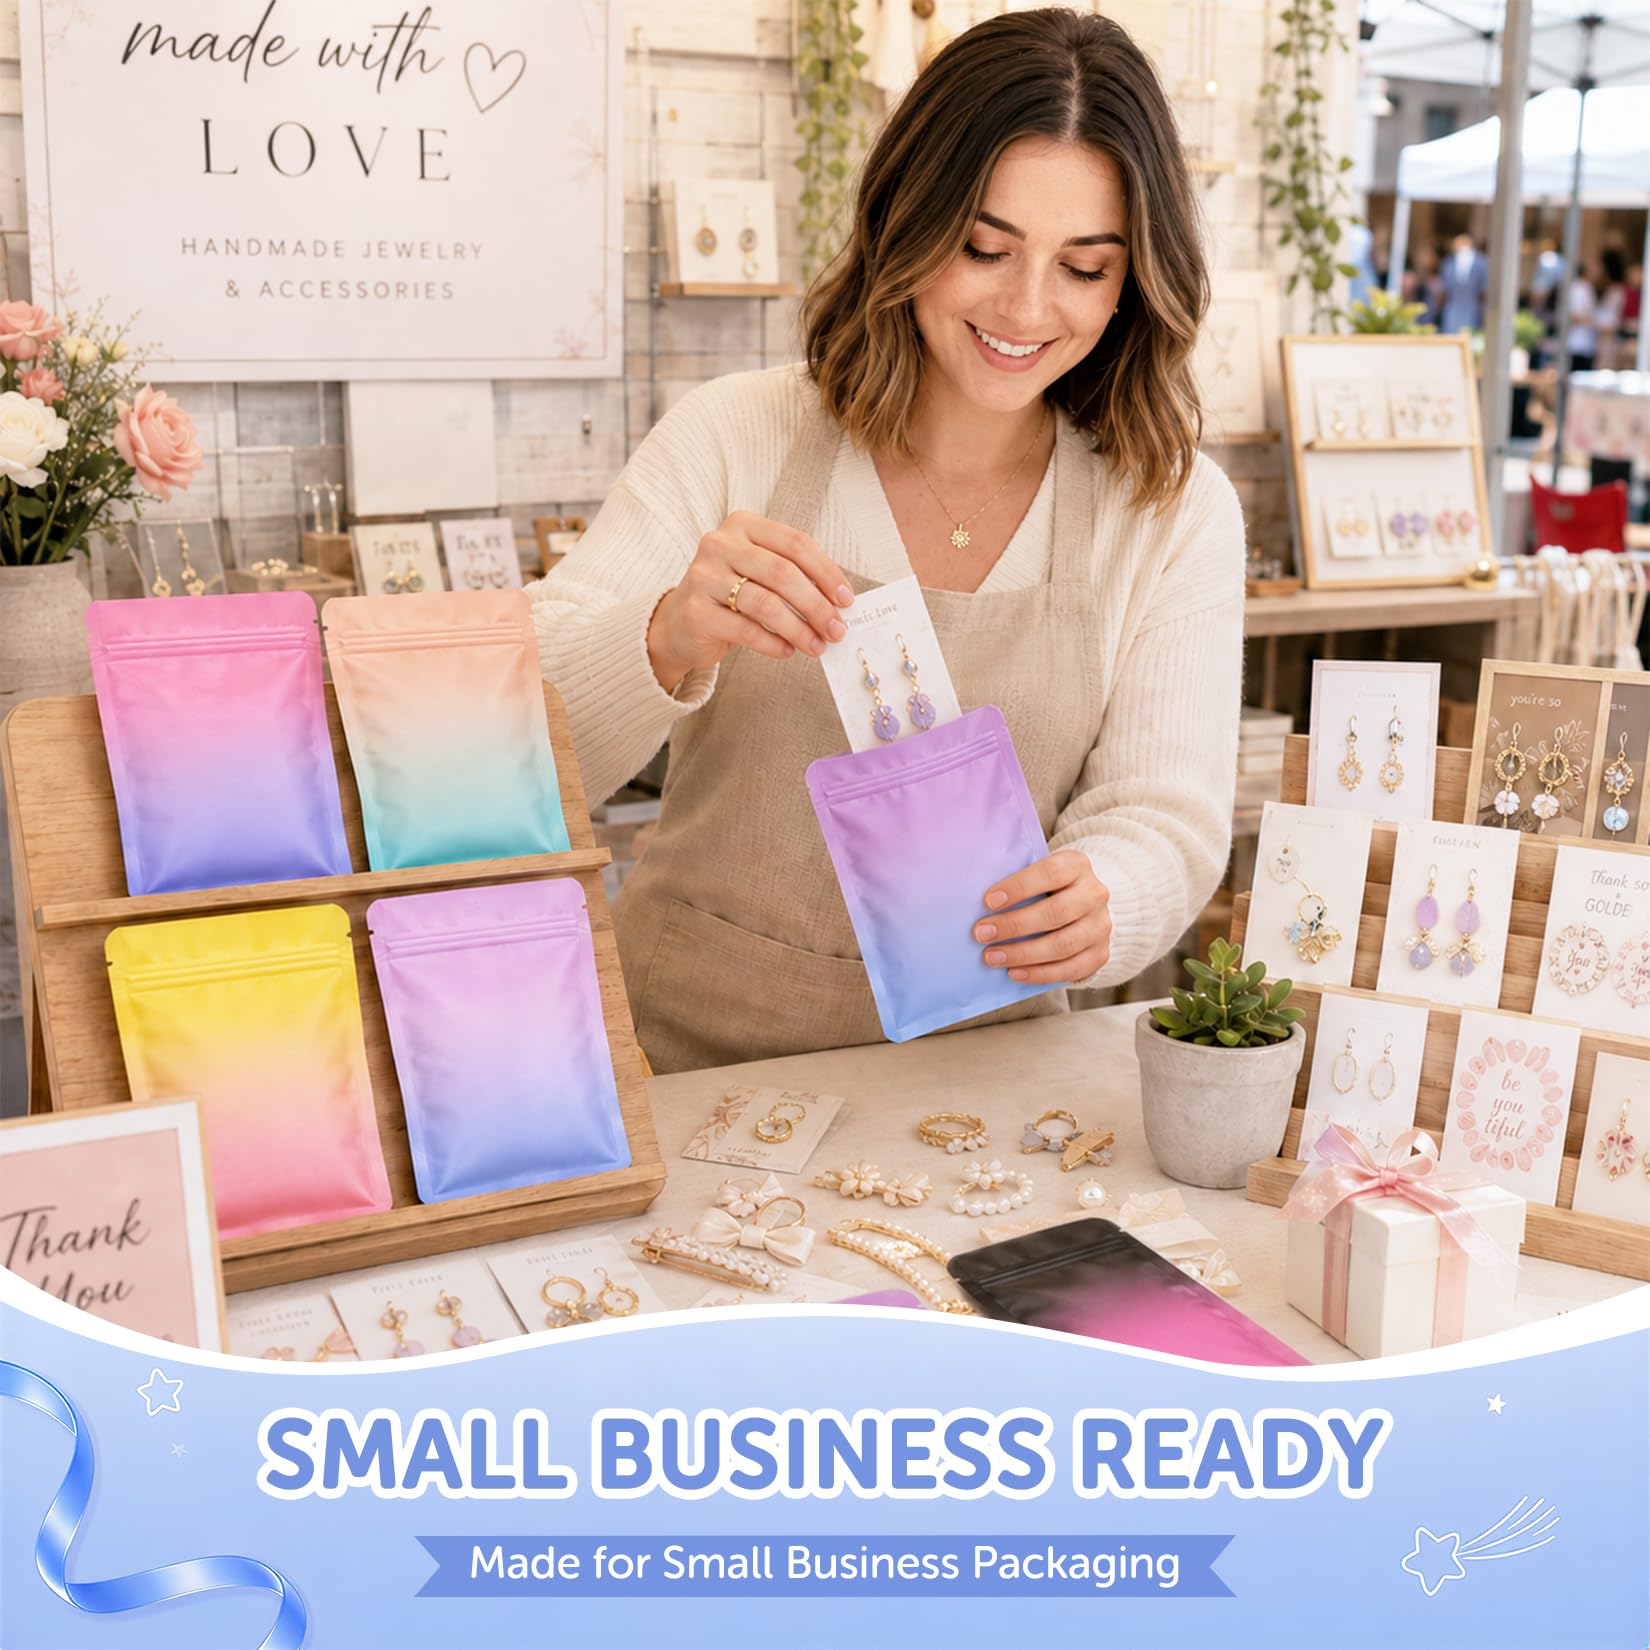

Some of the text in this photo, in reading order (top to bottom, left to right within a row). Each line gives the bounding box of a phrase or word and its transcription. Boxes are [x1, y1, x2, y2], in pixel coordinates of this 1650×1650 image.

[121, 0, 444, 94] made with
[202, 119, 450, 181] LOVE
[181, 237, 484, 260] HANDMADE JEWELRY
[225, 280, 455, 300] & ACCESSORIES
[1548, 697, 1562, 708] so
[1591, 869, 1629, 889] Thank
[1585, 897, 1632, 917] GOLDE
[1501, 1069, 1521, 1091] be
[1490, 1098, 1525, 1117] you
[1484, 1116, 1527, 1143] tiful
[0, 1197, 151, 1270] Thank
